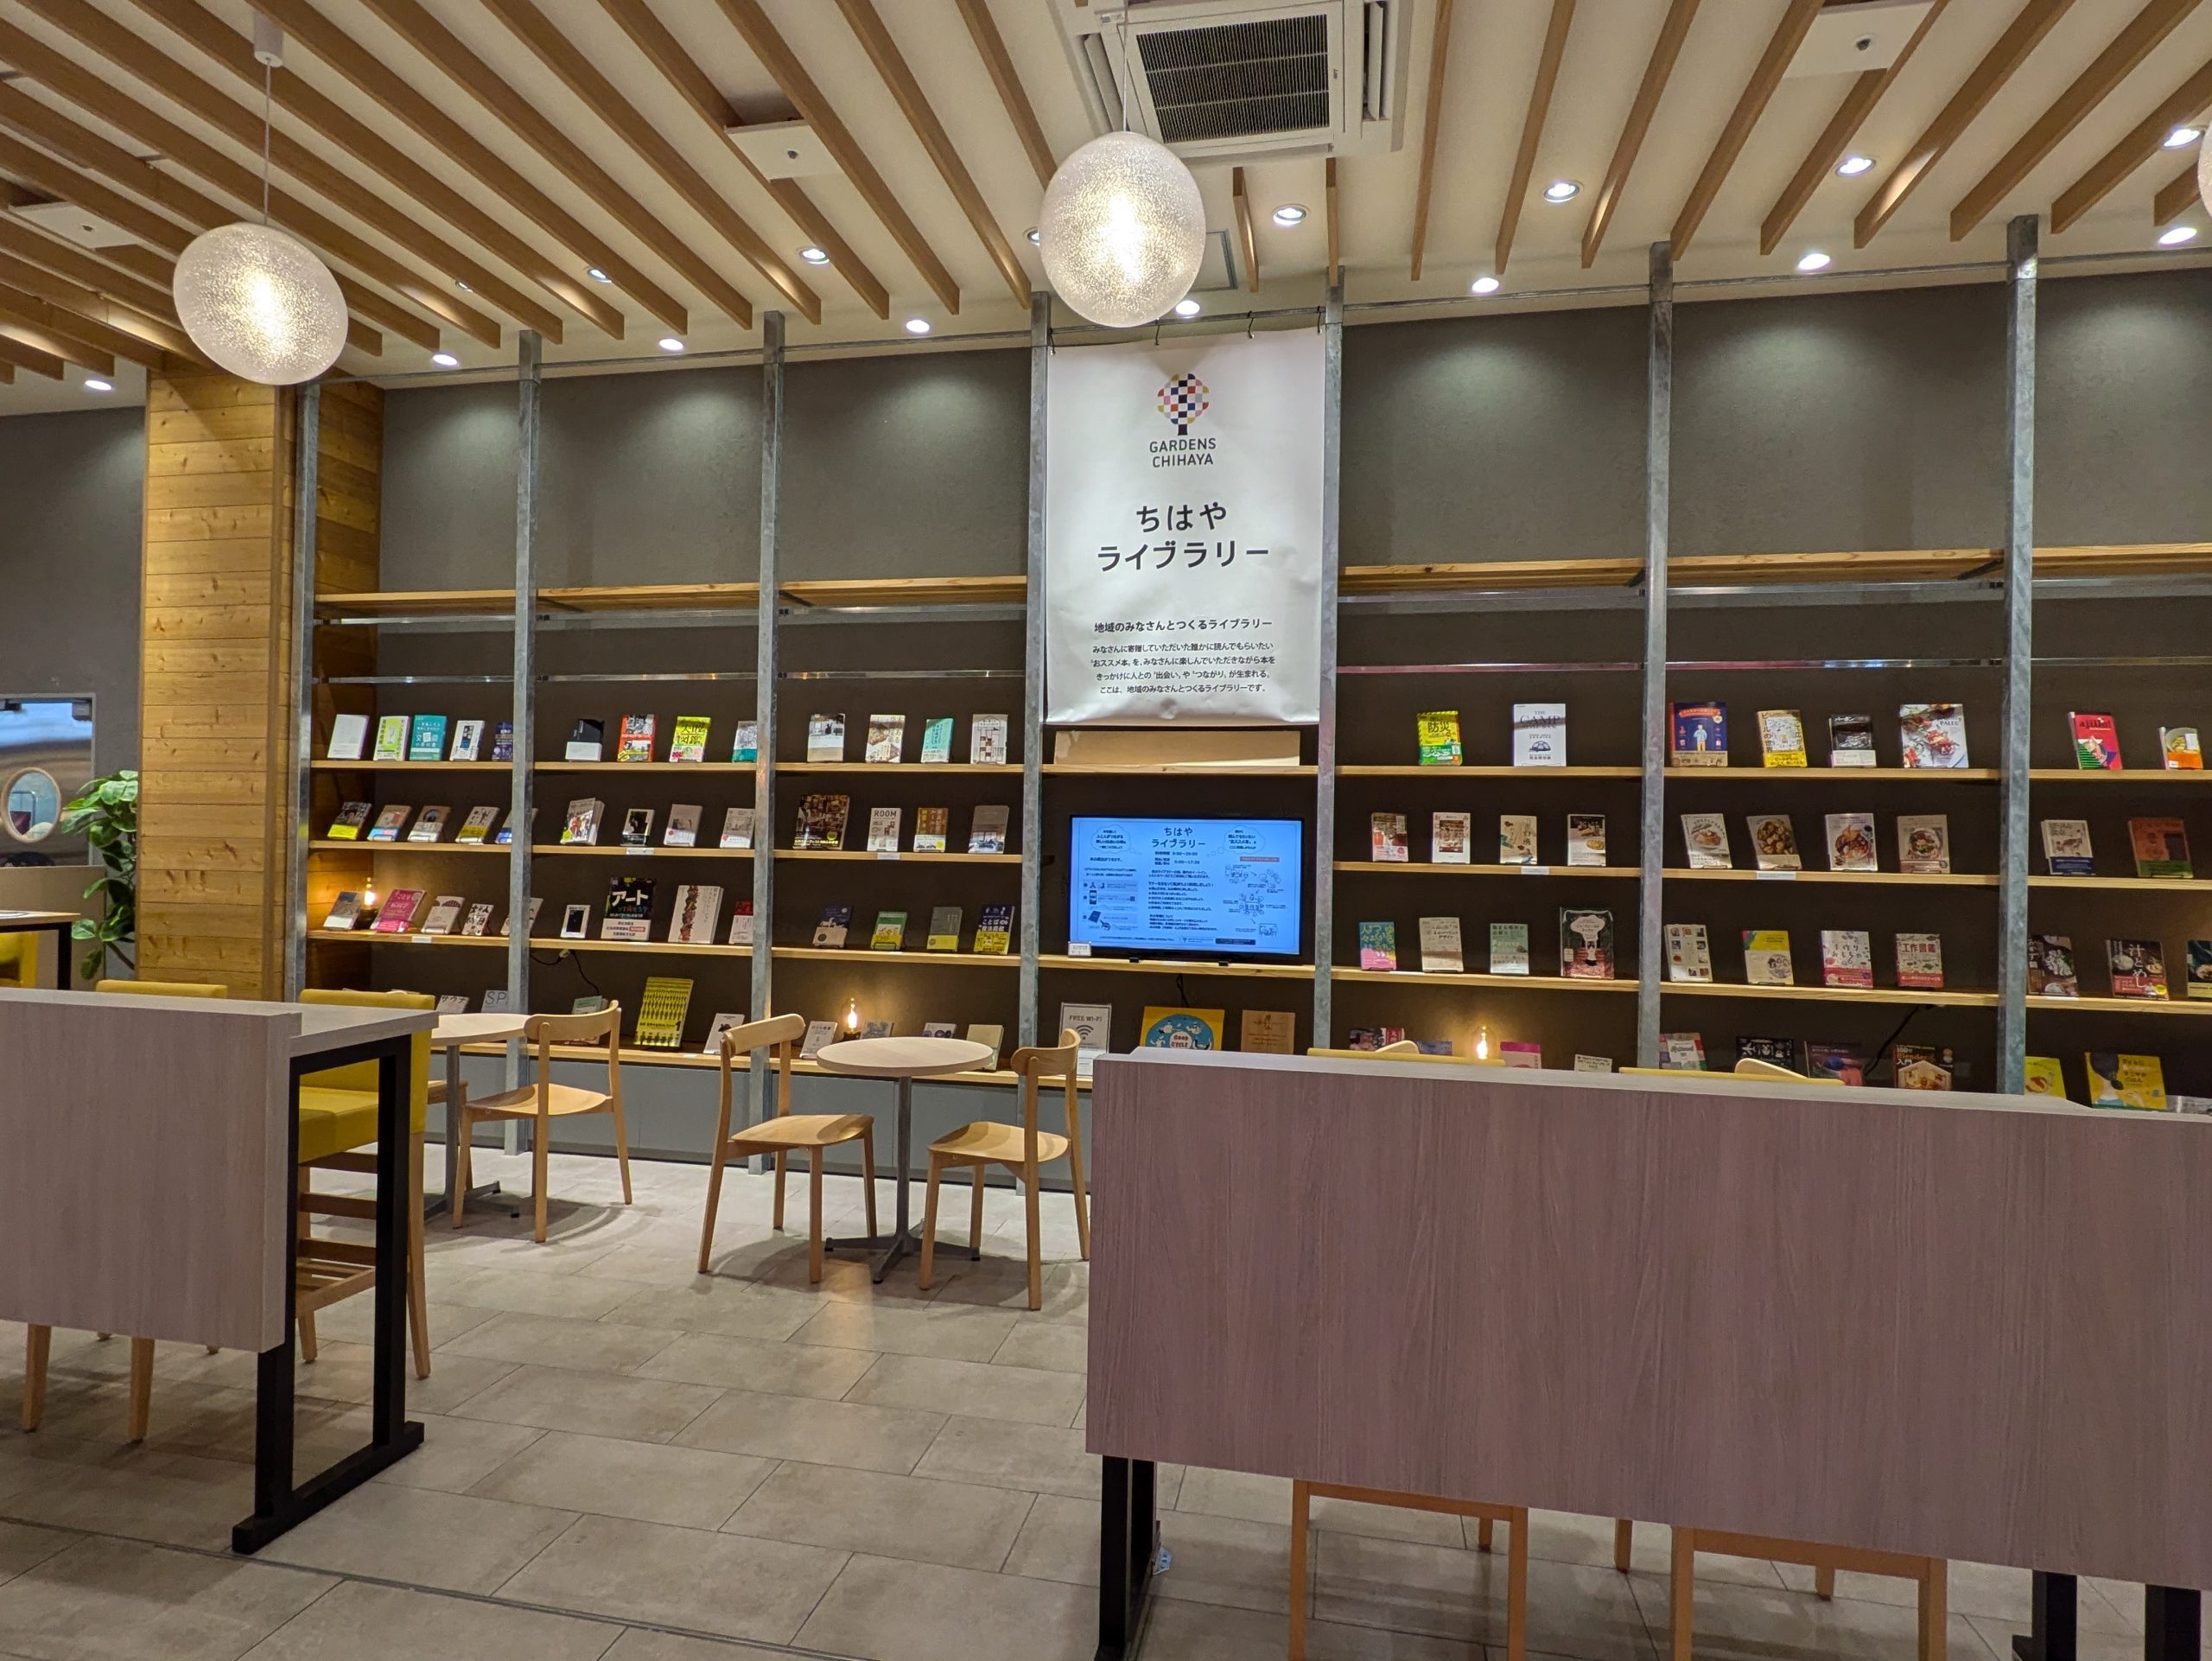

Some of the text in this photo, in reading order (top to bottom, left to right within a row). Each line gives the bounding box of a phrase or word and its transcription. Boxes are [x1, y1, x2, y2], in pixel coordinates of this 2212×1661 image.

[1149, 437, 1217, 454] GARDENS
[1153, 453, 1214, 468] CHIHAYA
[1136, 501, 1227, 533] ちはや
[1097, 539, 1269, 572] ライブラリー
[1094, 618, 1273, 633] 地域のみなさんとつくるライブラリー
[1427, 720, 1452, 734] 防災
[1163, 826, 1193, 837] ちはや
[1151, 838, 1206, 849] ライブラリー
[611, 889, 649, 907] アート
[1902, 943, 1936, 953] 工作図鑑
[485, 990, 508, 1006] SP
